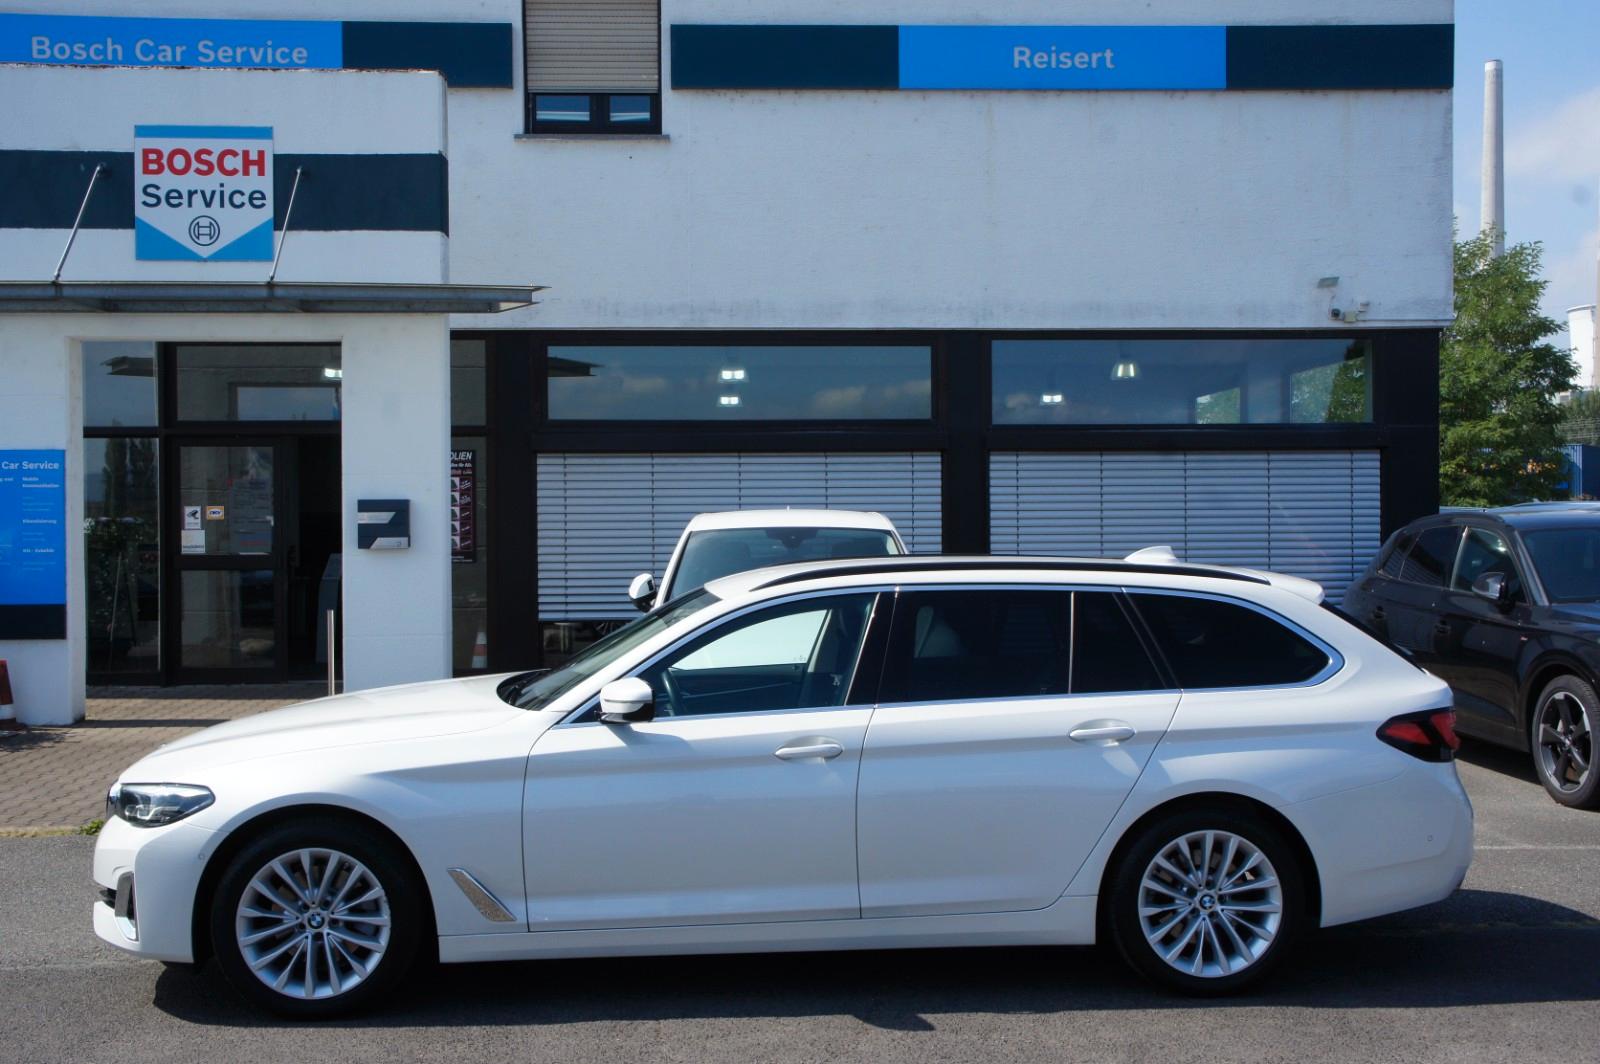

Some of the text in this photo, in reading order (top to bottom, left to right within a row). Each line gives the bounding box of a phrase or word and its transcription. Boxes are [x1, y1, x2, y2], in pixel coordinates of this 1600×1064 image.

[31, 36, 309, 65] Bosch Car Service
[1013, 45, 1115, 69] Reisert
[142, 148, 266, 177] BOSCH
[141, 182, 267, 210] Service
[1, 460, 59, 469] Car Service
